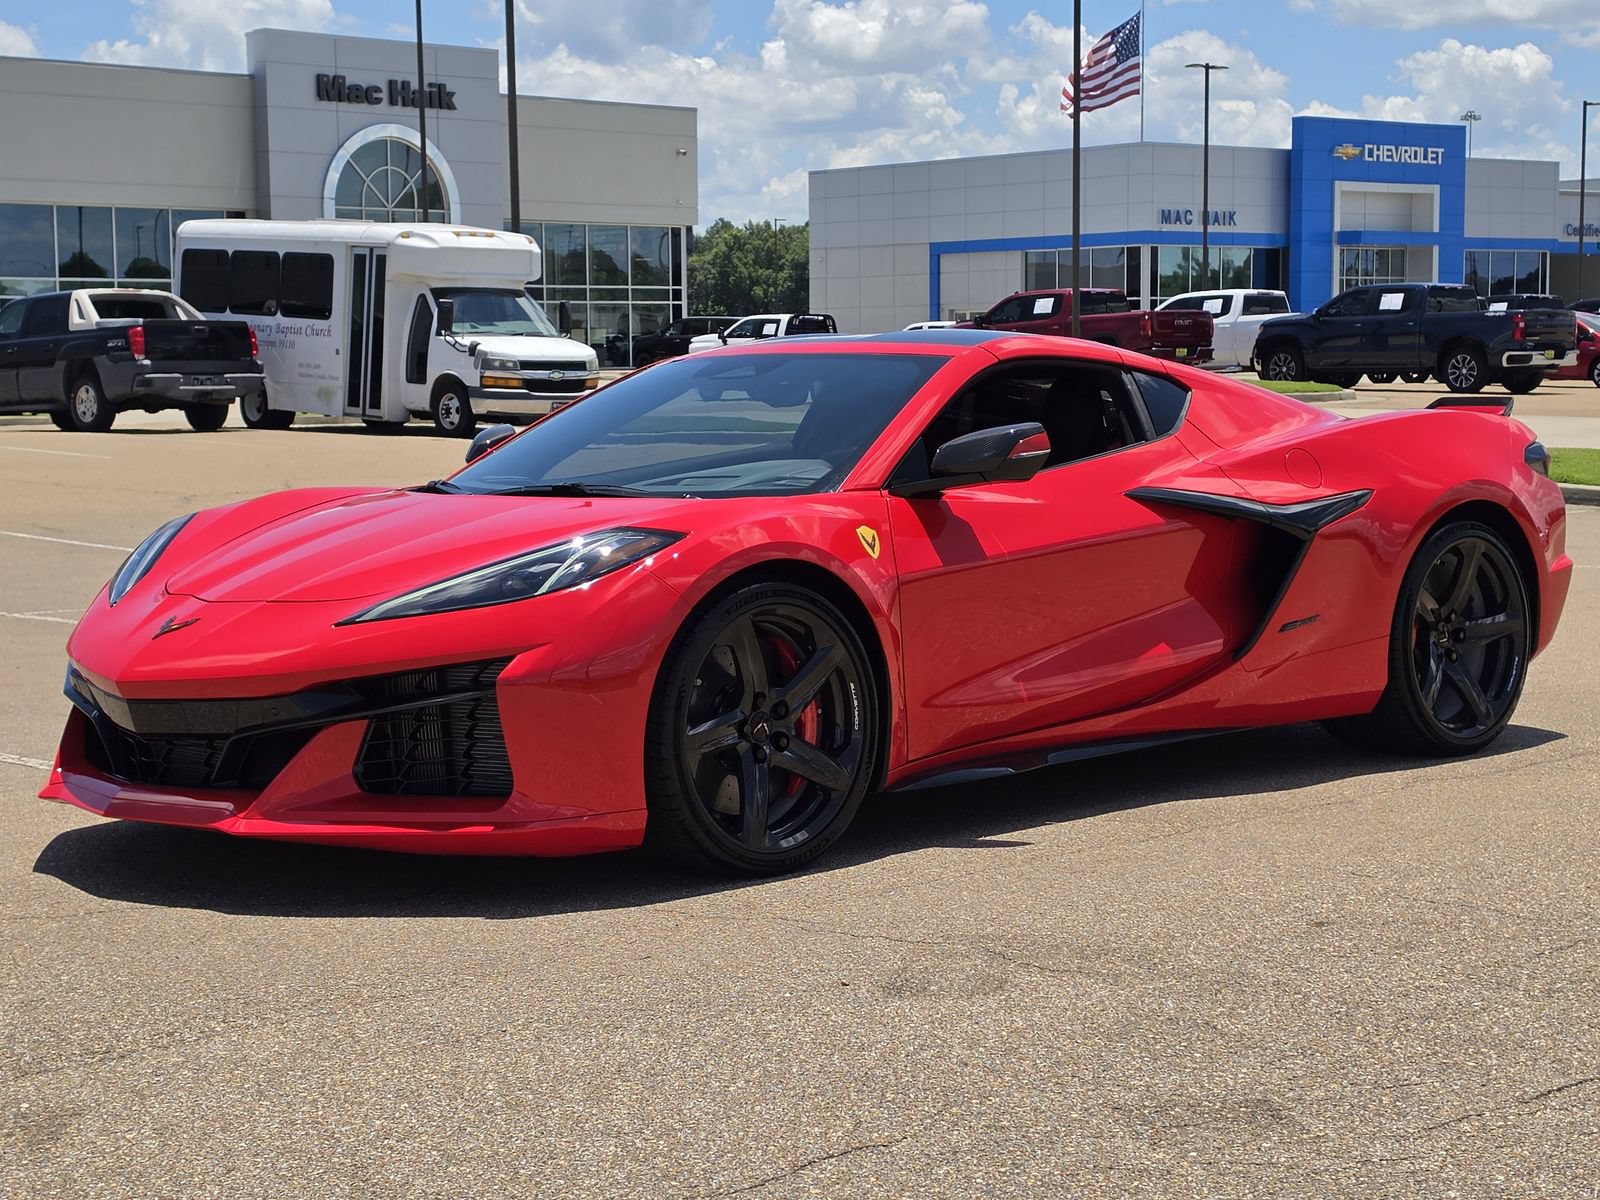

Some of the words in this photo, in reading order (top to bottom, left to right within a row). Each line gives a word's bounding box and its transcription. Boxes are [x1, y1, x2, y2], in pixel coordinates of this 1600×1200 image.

[316, 73, 383, 105] Mac
[388, 79, 457, 111] Haik
[1364, 144, 1445, 165] CHEVROLET
[1160, 209, 1193, 226] MAC
[275, 322, 302, 338] Baptist
[304, 323, 332, 337] Church
[849, 682, 859, 730] CORVETTE
